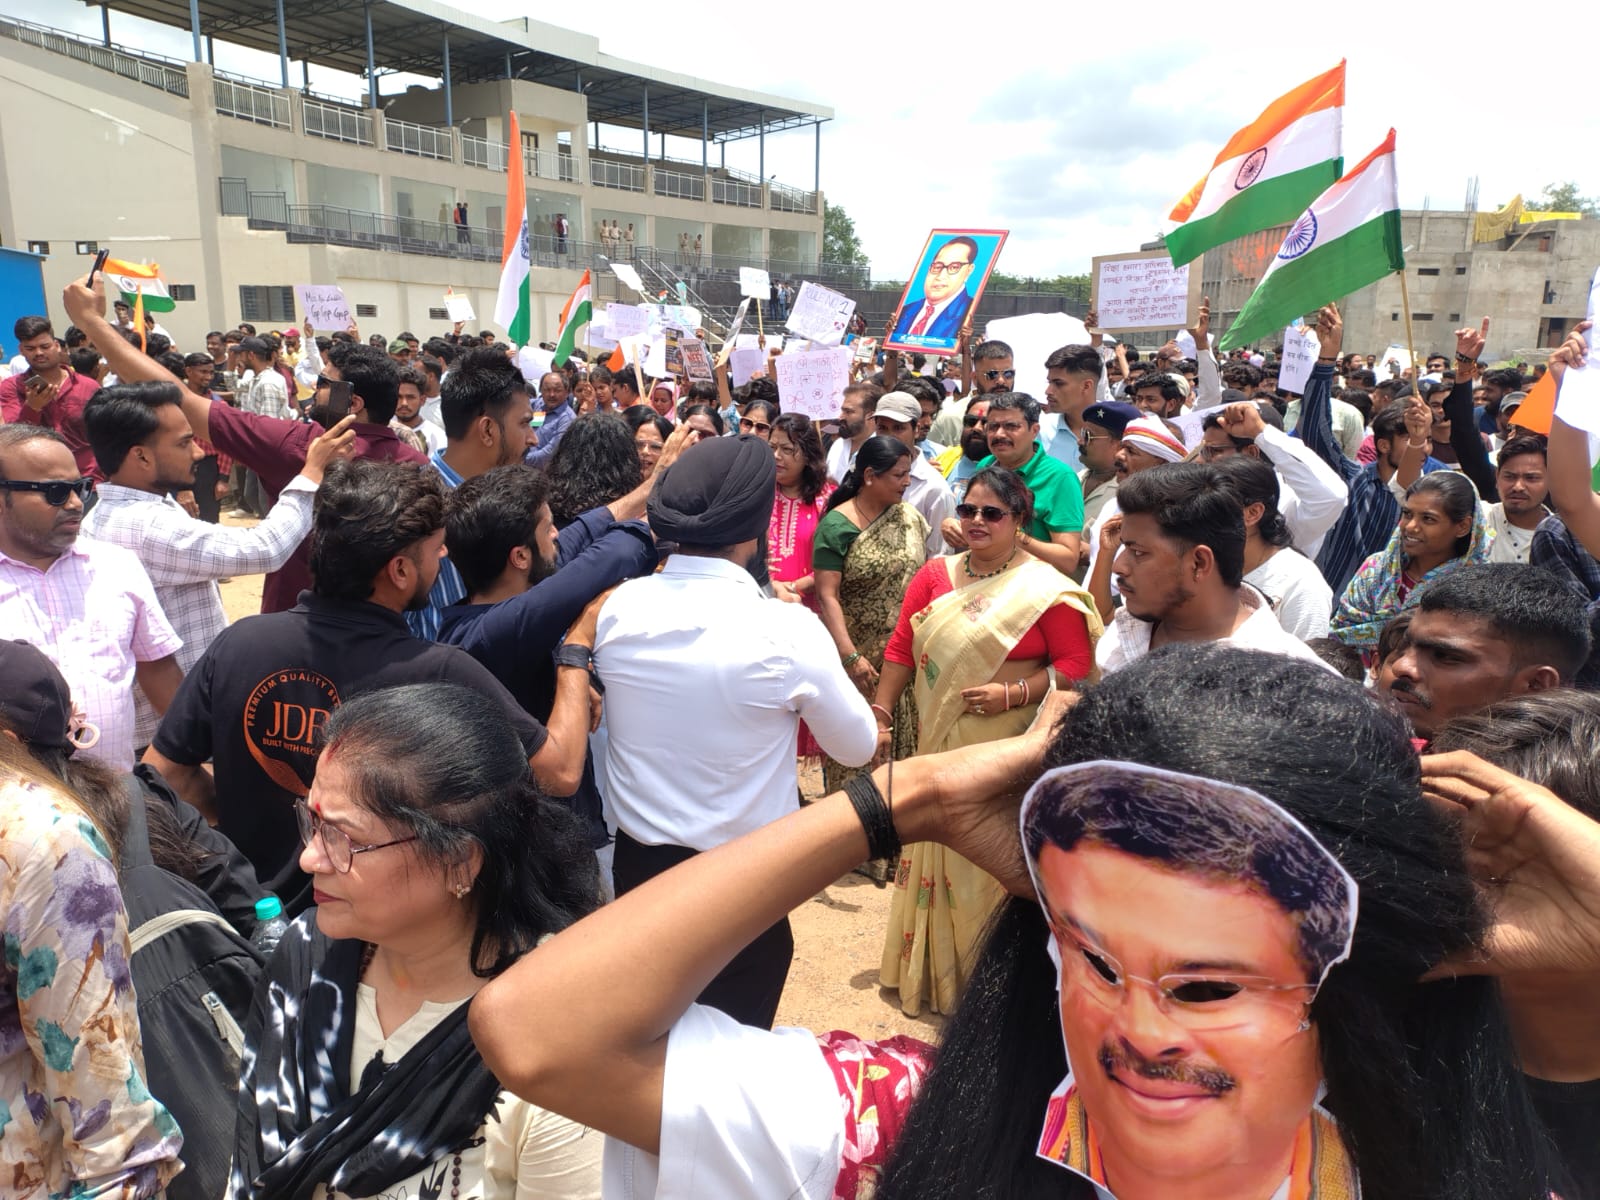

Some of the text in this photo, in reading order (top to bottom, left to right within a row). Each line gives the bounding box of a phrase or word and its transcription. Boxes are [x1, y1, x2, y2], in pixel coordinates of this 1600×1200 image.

[247, 680, 277, 727] PREMIUM
[280, 672, 327, 689] QUALITY
[262, 737, 282, 747] BUILT
[283, 742, 300, 752] WITH
